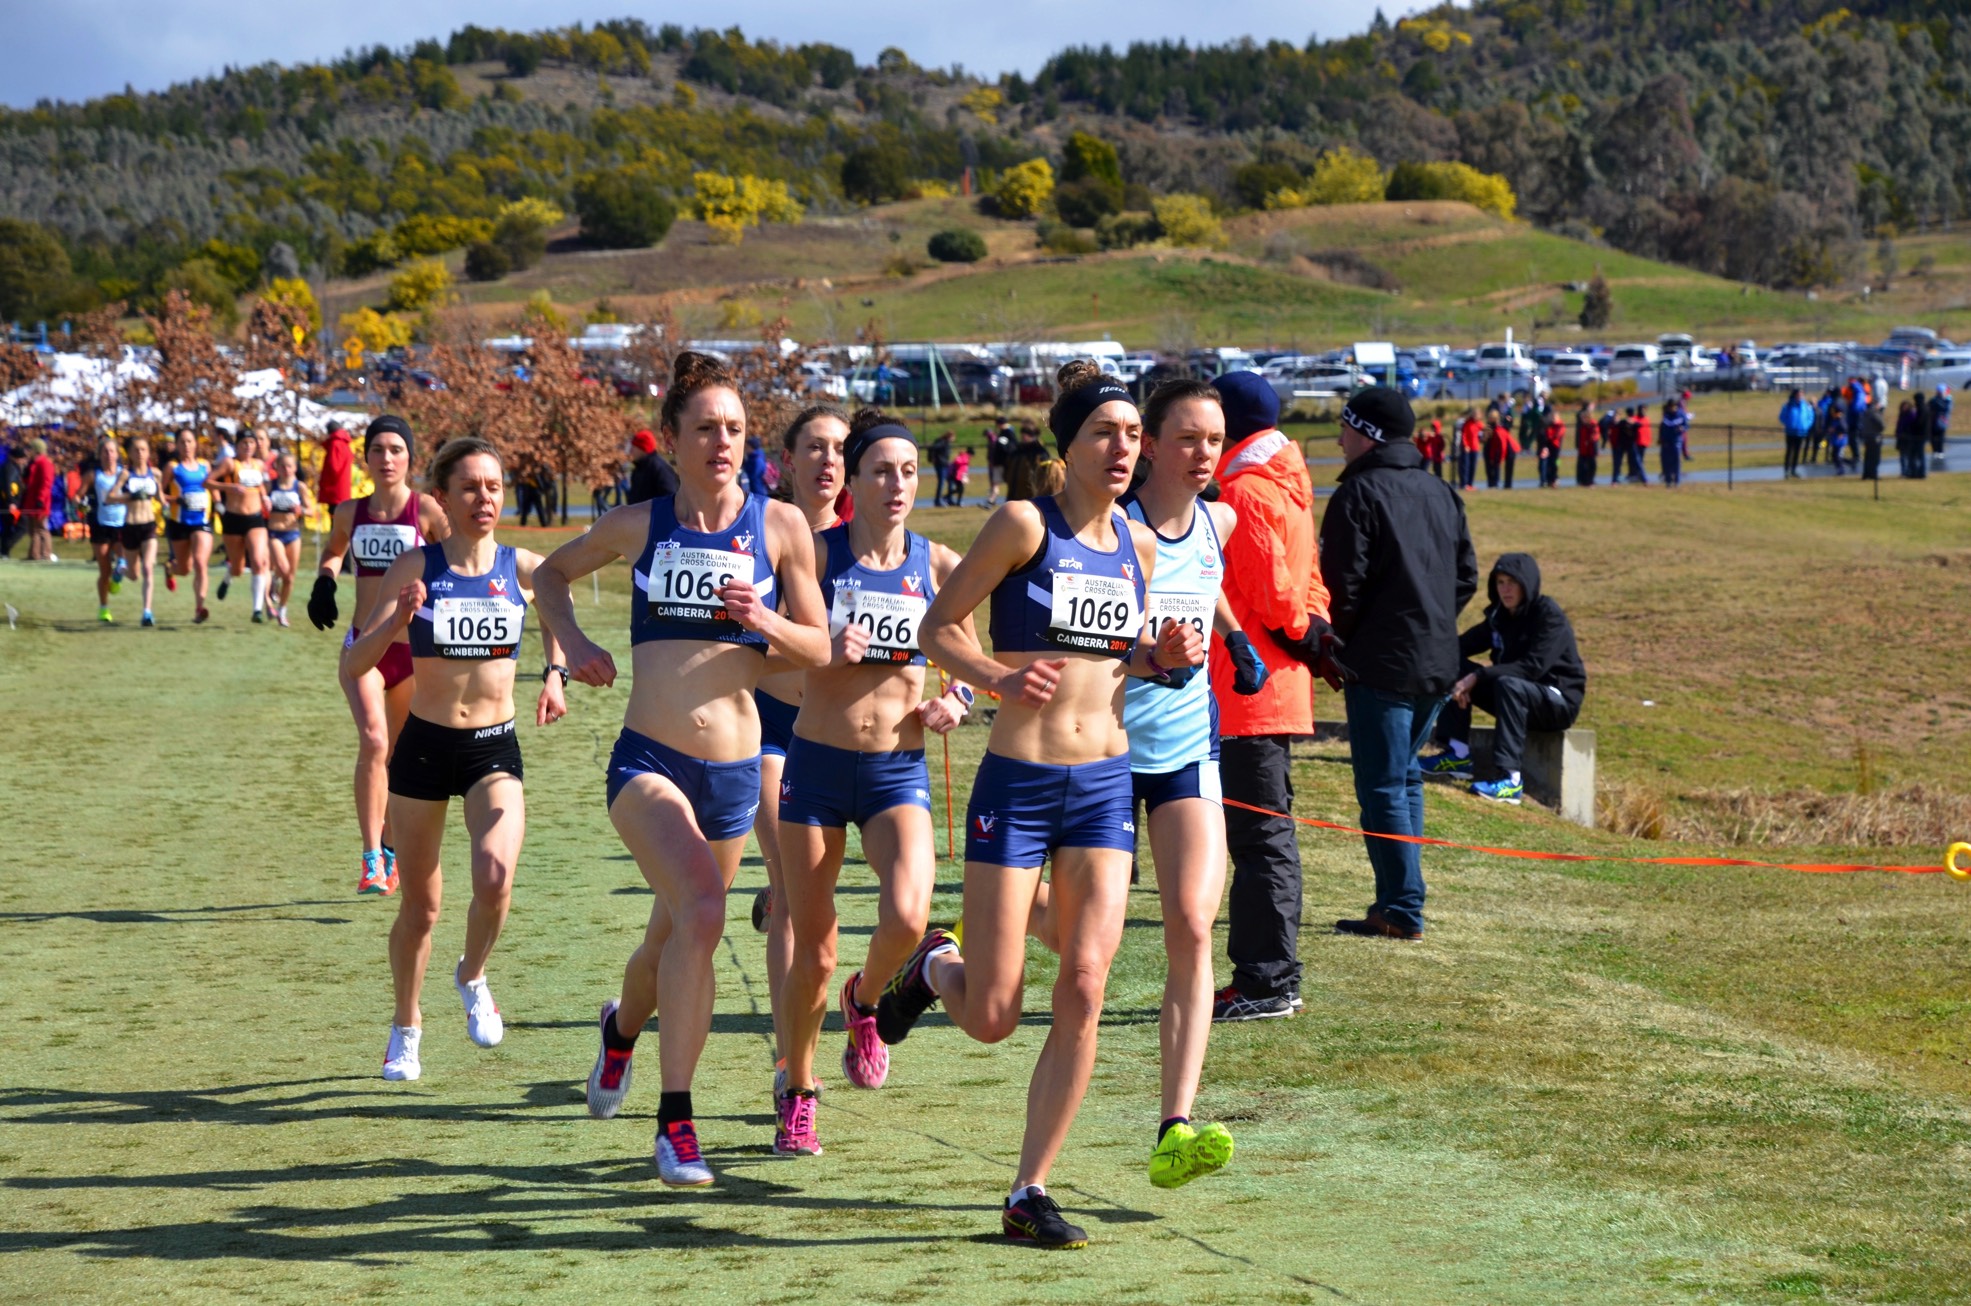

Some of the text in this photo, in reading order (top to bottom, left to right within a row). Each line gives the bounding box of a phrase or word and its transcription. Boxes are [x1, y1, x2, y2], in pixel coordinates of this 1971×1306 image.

[1342, 406, 1386, 442] CURL
[361, 538, 404, 557] 1040
[656, 538, 681, 549] STAR
[680, 551, 728, 561] AUSTRALIAN
[680, 558, 741, 570] CROSS COUNTRY
[1058, 557, 1083, 571] STAR
[1084, 578, 1125, 589] AUSTRALIAN
[1084, 586, 1128, 597] CROSS COUN
[863, 594, 906, 605] AUSTRALIAN
[862, 602, 885, 610] CROSS
[1160, 604, 1181, 612] CROSS
[657, 606, 712, 619] CANBERRA
[1068, 596, 1129, 631] 1069
[447, 617, 508, 641] 1065
[1149, 616, 1204, 643] 18
[1056, 633, 1128, 651] CANBERRA 2016
[443, 647, 510, 656] CANBERRA 2016
[892, 651, 909, 660] 2016
[474, 719, 515, 739] NIKE PR
